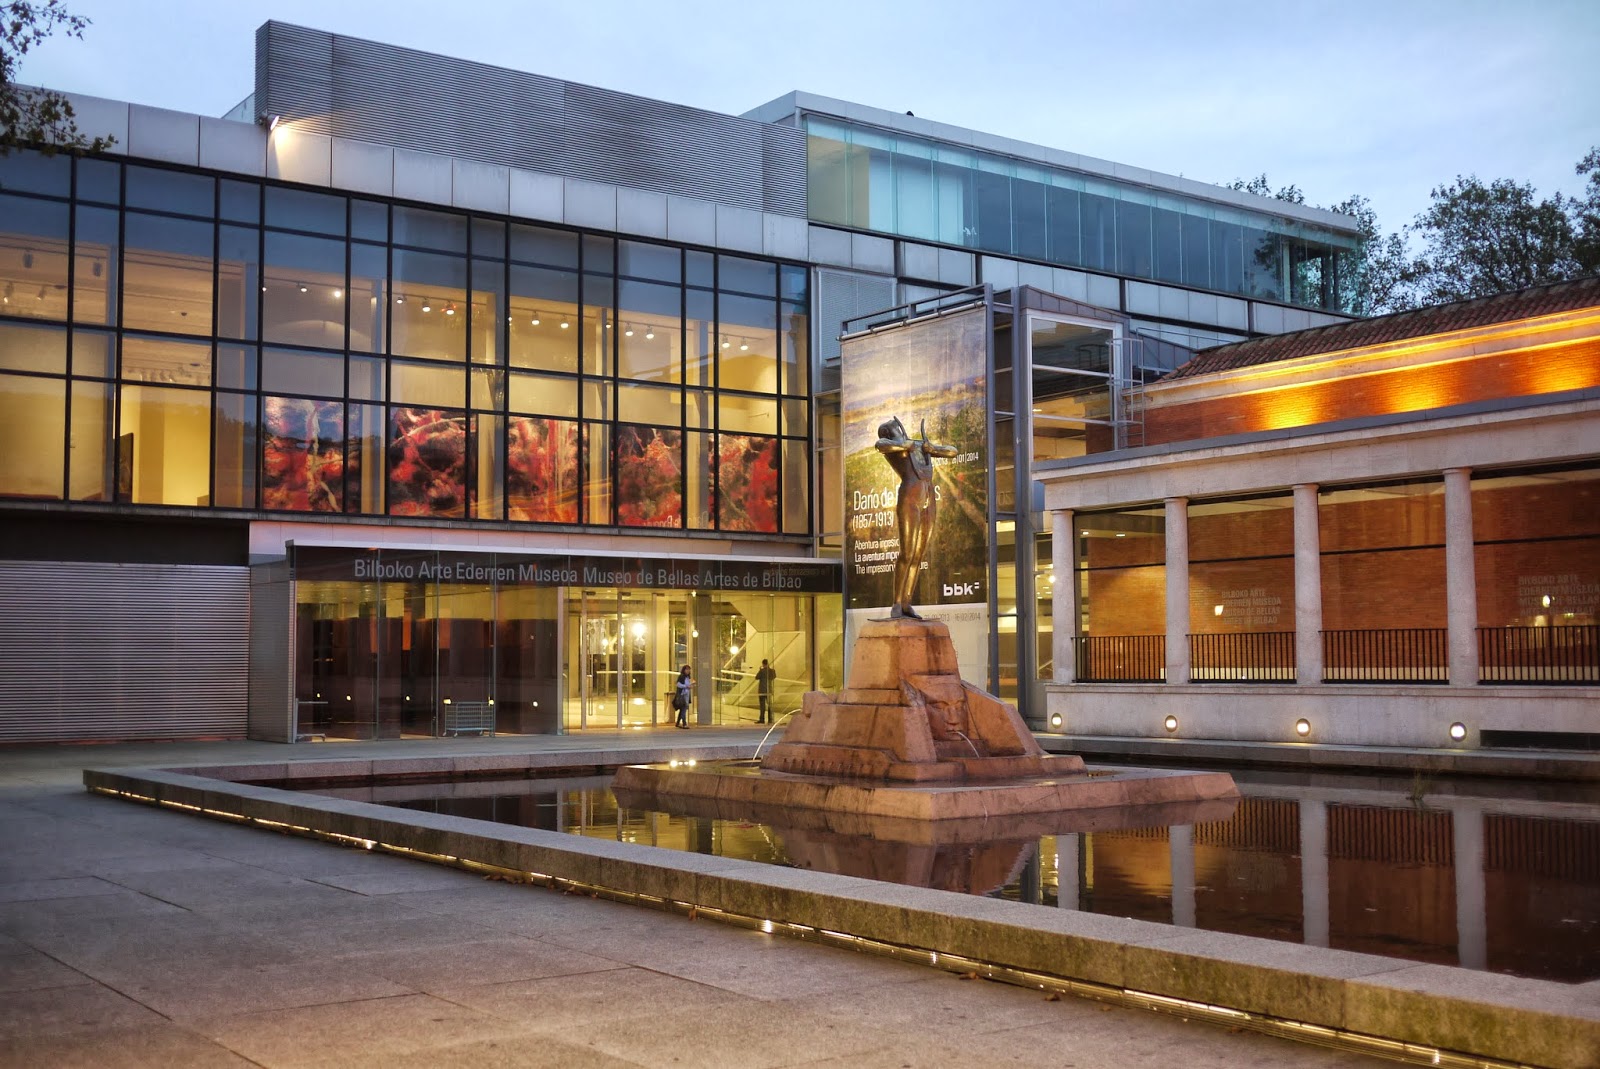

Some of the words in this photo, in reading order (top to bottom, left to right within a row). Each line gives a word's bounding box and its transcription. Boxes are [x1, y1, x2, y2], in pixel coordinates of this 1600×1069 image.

[881, 486, 894, 508] de
[852, 510, 894, 532] (1857-1913)
[854, 552, 862, 563] La
[862, 551, 885, 562] aventura
[354, 559, 414, 578] Bilboko
[418, 560, 452, 580] Arte
[456, 561, 515, 581] Ederren
[519, 563, 578, 583] Museoa
[583, 567, 632, 585] Museo
[636, 569, 653, 585] de
[658, 568, 700, 587] Bellas
[703, 570, 739, 588] Artes
[742, 572, 758, 588] de
[762, 571, 802, 589] Bilbao
[855, 564, 866, 575] The
[943, 583, 973, 597] bbk
